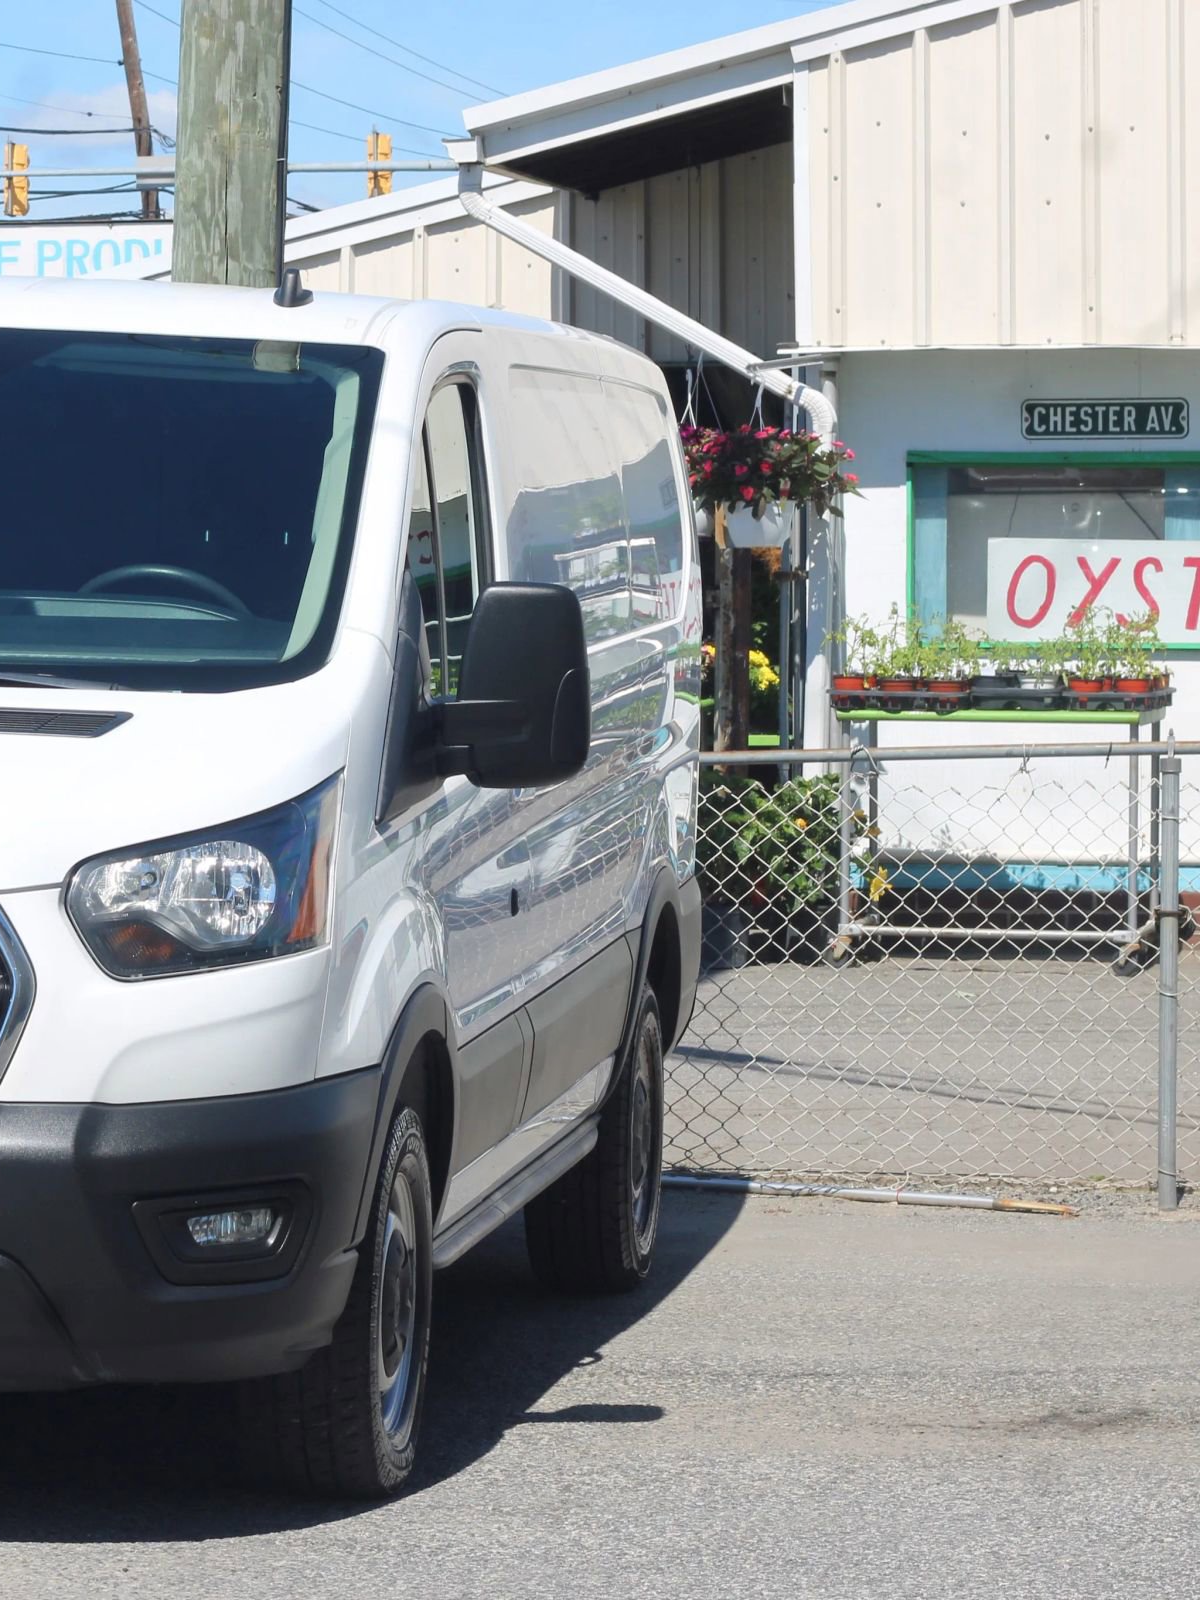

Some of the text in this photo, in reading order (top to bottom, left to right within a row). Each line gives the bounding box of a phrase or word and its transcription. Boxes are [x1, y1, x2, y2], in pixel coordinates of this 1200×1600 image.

[36, 238, 163, 278] PROD
[1033, 405, 1177, 433] CHESTER AV.
